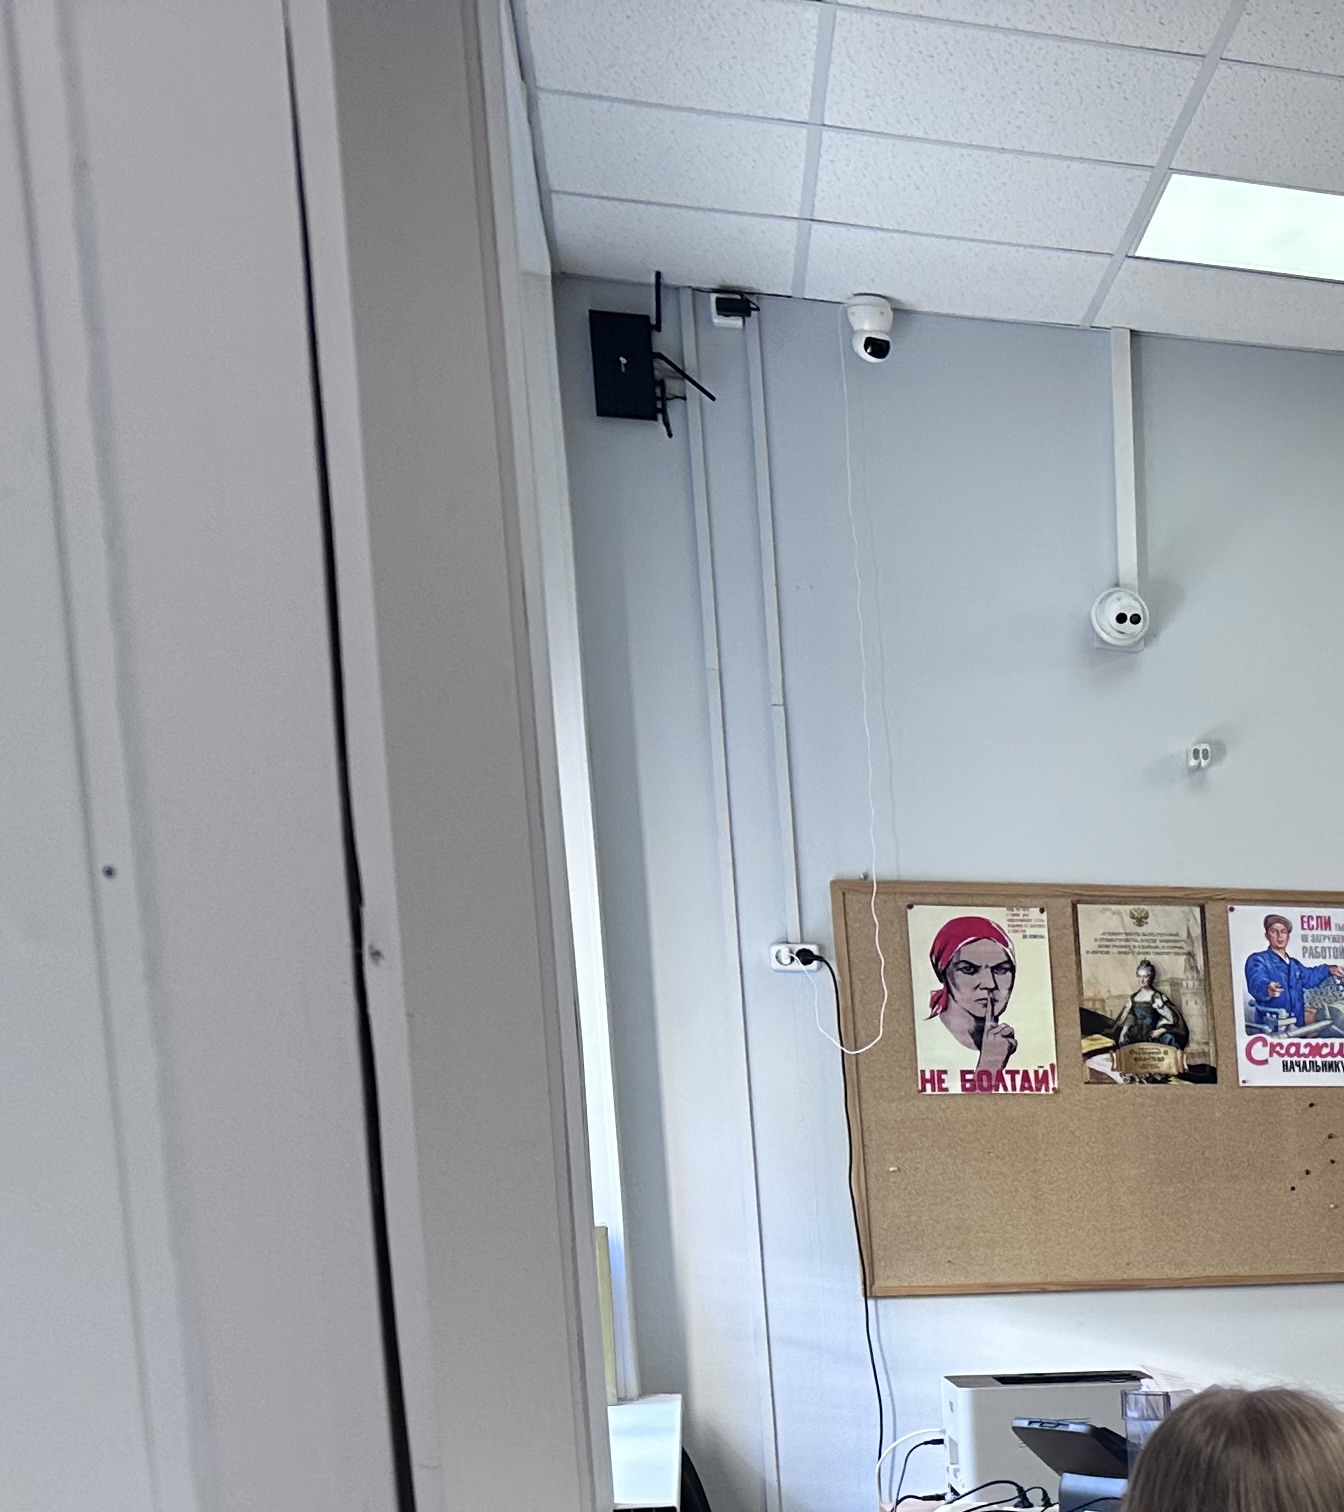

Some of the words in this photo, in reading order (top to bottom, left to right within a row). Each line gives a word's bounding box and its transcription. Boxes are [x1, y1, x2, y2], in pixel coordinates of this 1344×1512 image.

[1300, 914, 1332, 932] ЕСЛИ
[920, 1069, 949, 1093] НЕ
[960, 1063, 1057, 1093] БОЛТАЙ!
